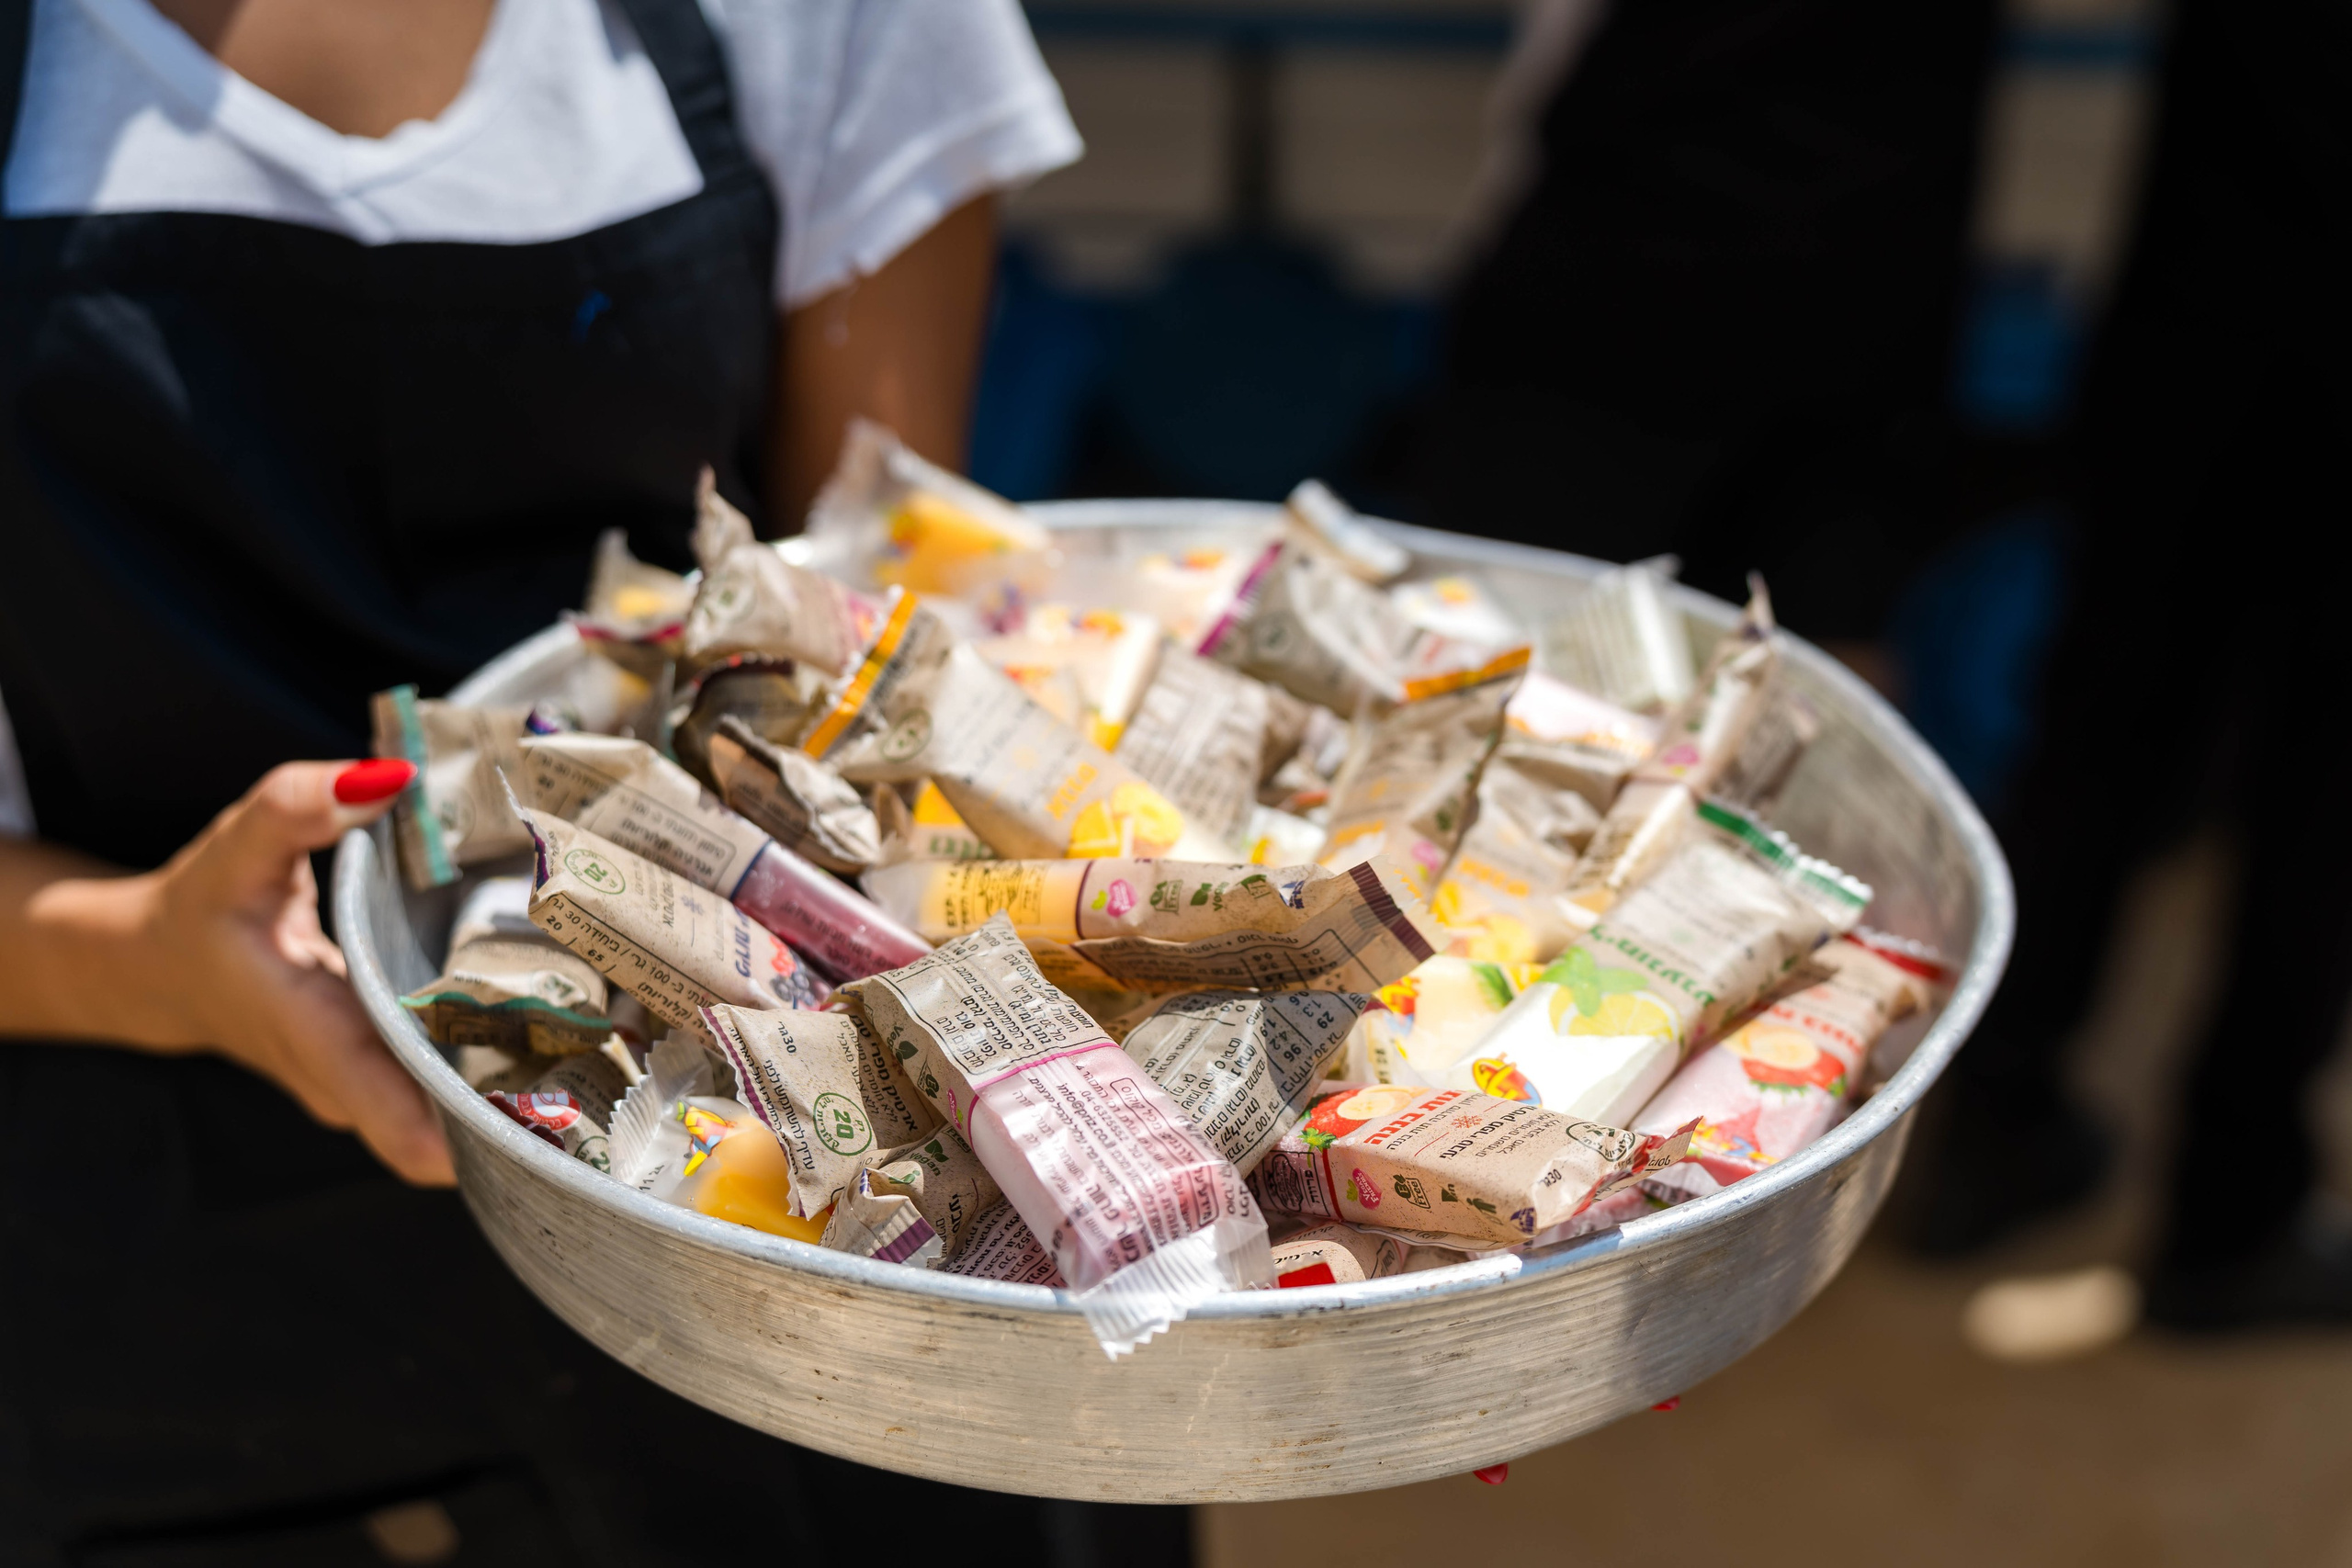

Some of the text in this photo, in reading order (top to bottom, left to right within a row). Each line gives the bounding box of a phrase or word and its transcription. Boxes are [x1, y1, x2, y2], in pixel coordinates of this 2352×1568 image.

[543, 913, 564, 933] 20
[562, 907, 584, 927] 30
[577, 919, 624, 953] ביחידה
[586, 947, 605, 964] 65
[648, 964, 672, 985] 100
[636, 978, 694, 1025] (קלוריות)
[1256, 1015, 1277, 1039] 1.9
[762, 1058, 782, 1085] לפני
[835, 1032, 879, 1115] ללא צבעי מאכל
[840, 1020, 899, 1123] ללא חומרים משמרים
[1074, 1062, 1084, 1071] 4
[1201, 1111, 1230, 1140] ומנים
[1223, 1085, 1250, 1116] (גרם)
[1268, 1027, 1291, 1052] 4.2
[1300, 996, 1322, 1019] 1.3
[1217, 1097, 1262, 1145] (קלוריות)
[1281, 1041, 1302, 1063] 96
[1315, 1009, 1336, 1031] 29
[866, 1042, 918, 1133] ארטיק מפרי
[1119, 1084, 1146, 1113] קוקוס
[1252, 1111, 1272, 1134] 100
[1279, 1057, 1317, 1094] ביחידה
[1311, 1040, 1329, 1059] 30
[772, 1083, 806, 1142] להשתמש
[827, 1104, 857, 1144] 20
[854, 1117, 865, 1133] רק
[1140, 1106, 1165, 1133] מכיל
[812, 1109, 841, 1150] קלוריות
[1363, 1112, 1425, 1145] בננה
[1385, 1129, 1413, 1154] בננה
[1470, 1117, 1504, 1140] מפרי
[795, 1141, 815, 1171] עדיף
[1439, 1136, 1474, 1160] טבעי
[910, 1151, 941, 1177] Vegan
[1084, 1179, 1121, 1224] פרווה
[1303, 1168, 1320, 1205] פרווה
[1354, 1175, 1370, 1201] VEGAN
[1357, 1170, 1378, 1202] FRIENDLY
[1410, 1179, 1426, 1206] Free
[950, 1194, 961, 1233] טבעי
[1114, 1222, 1143, 1264] כשר
